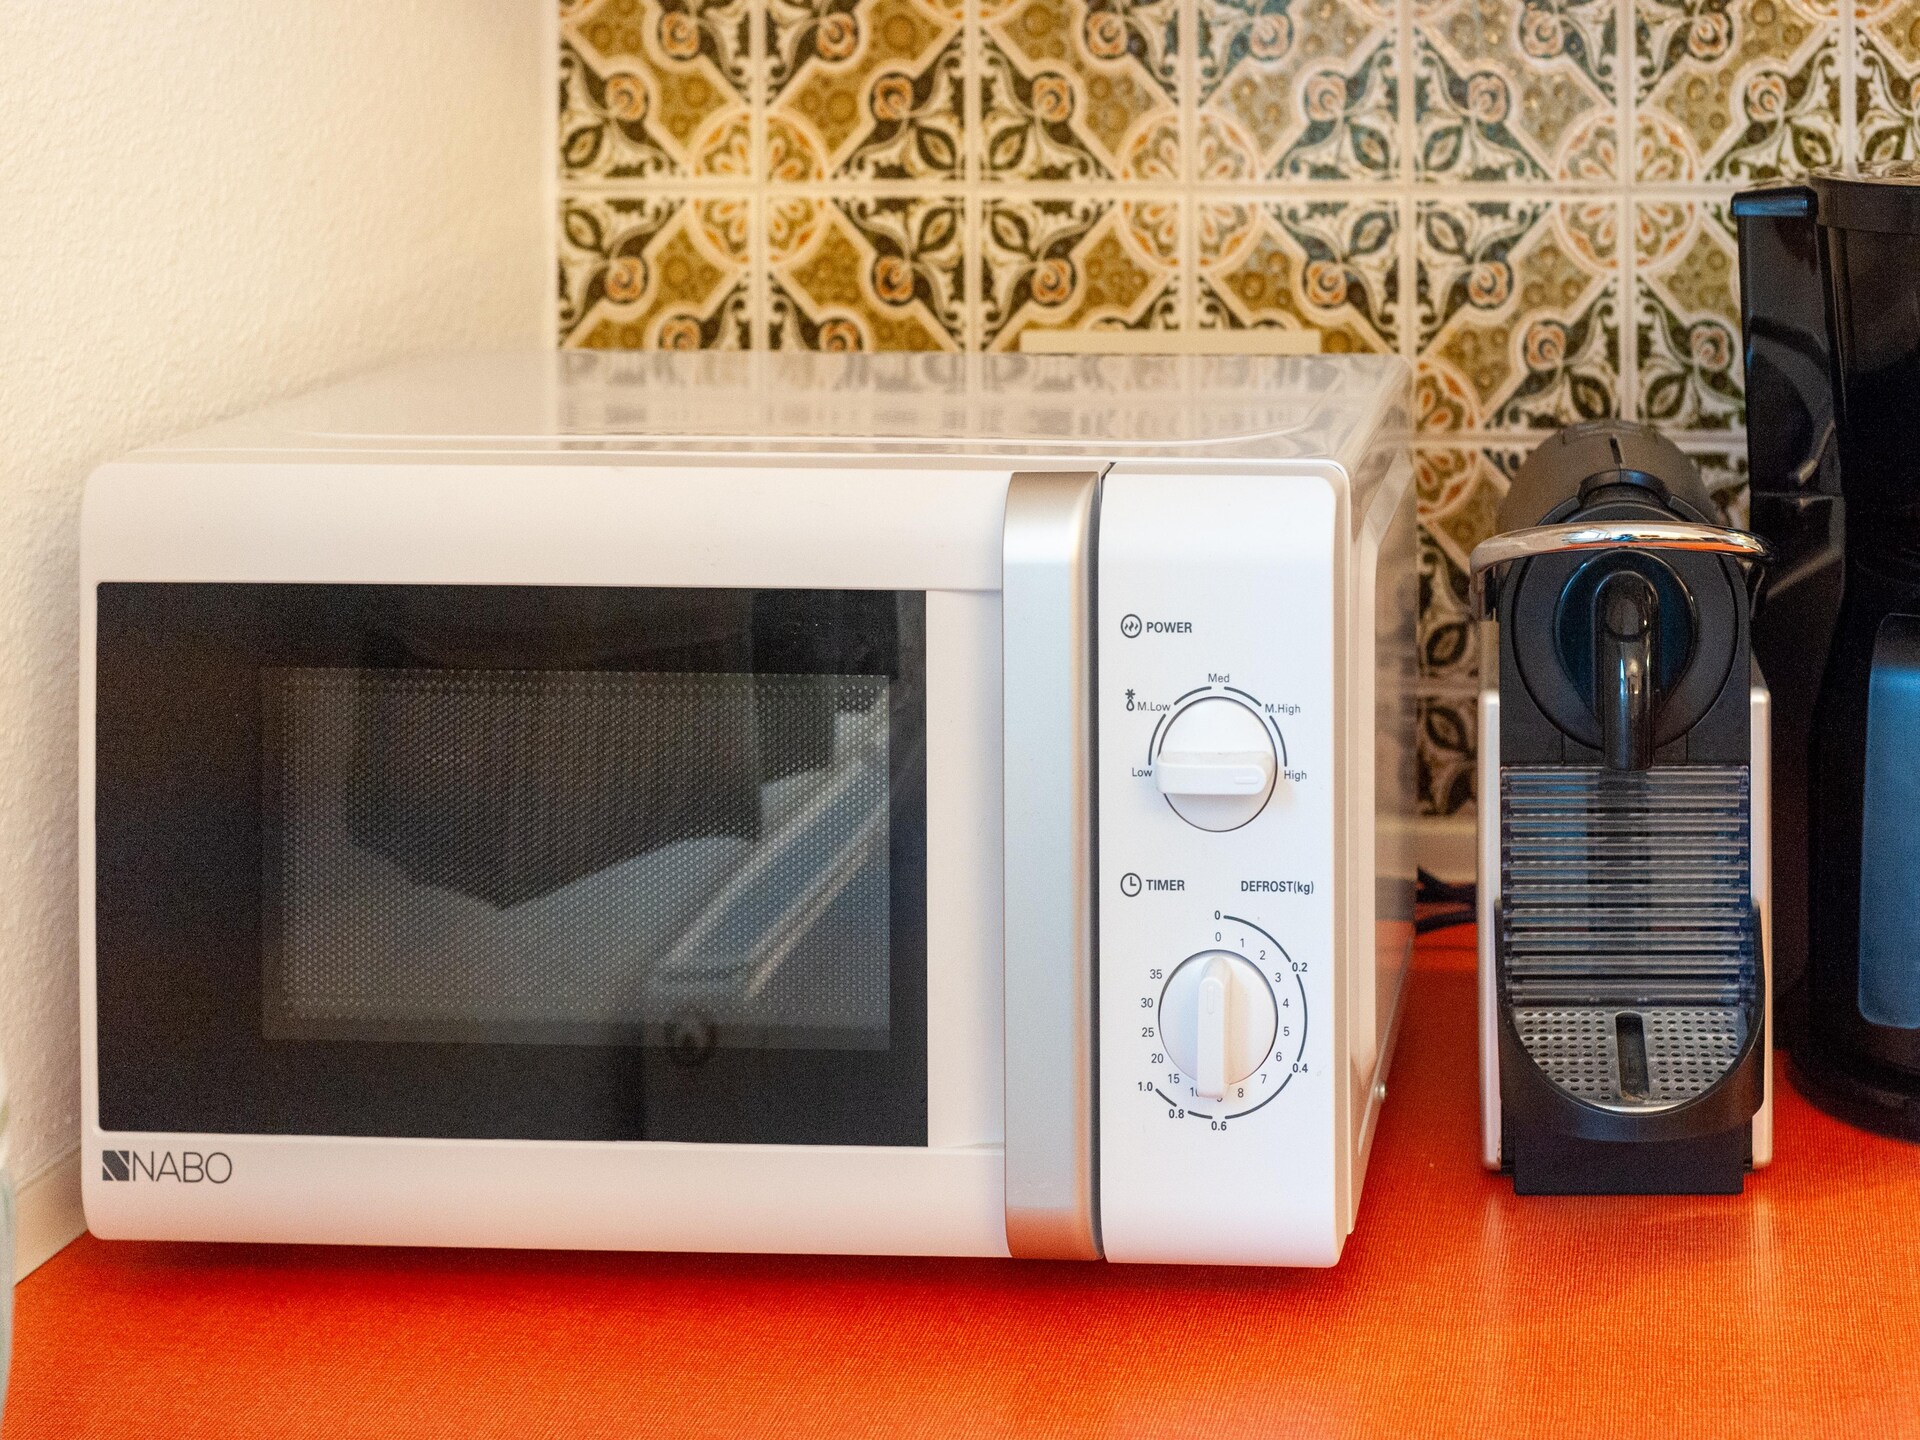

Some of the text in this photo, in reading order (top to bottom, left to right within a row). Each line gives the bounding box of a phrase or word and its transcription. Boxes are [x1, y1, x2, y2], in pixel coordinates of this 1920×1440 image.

[1146, 621, 1192, 634] POWER
[1207, 673, 1230, 684] Med
[1137, 702, 1172, 712] M.Low
[1264, 703, 1301, 716] M.High
[1131, 768, 1153, 778] Low
[1283, 770, 1308, 782] High
[1146, 879, 1185, 891] TIMER
[1240, 880, 1315, 896] DEFROST(kg)
[1214, 910, 1221, 921] 0
[1214, 931, 1222, 943] 0
[1239, 938, 1245, 948] 1
[1259, 950, 1266, 961] 2
[1291, 962, 1308, 973] 0.2
[1149, 969, 1163, 980] 35
[1274, 972, 1282, 983] 3
[1140, 997, 1154, 1009] 30
[1282, 997, 1290, 1009] 4
[1141, 1026, 1155, 1038] 25
[1283, 1026, 1290, 1037] 5
[1151, 1053, 1165, 1064] 20
[1275, 1051, 1283, 1063] 6
[1292, 1062, 1309, 1074] 0.4
[1167, 1073, 1181, 1085] 15
[1260, 1073, 1267, 1085] 7
[1137, 1081, 1154, 1093] 1.0
[1237, 1087, 1245, 1099] 8
[1168, 1109, 1185, 1120] 0.8
[1211, 1120, 1228, 1132] 0.6
[132, 1150, 233, 1185] NABO
